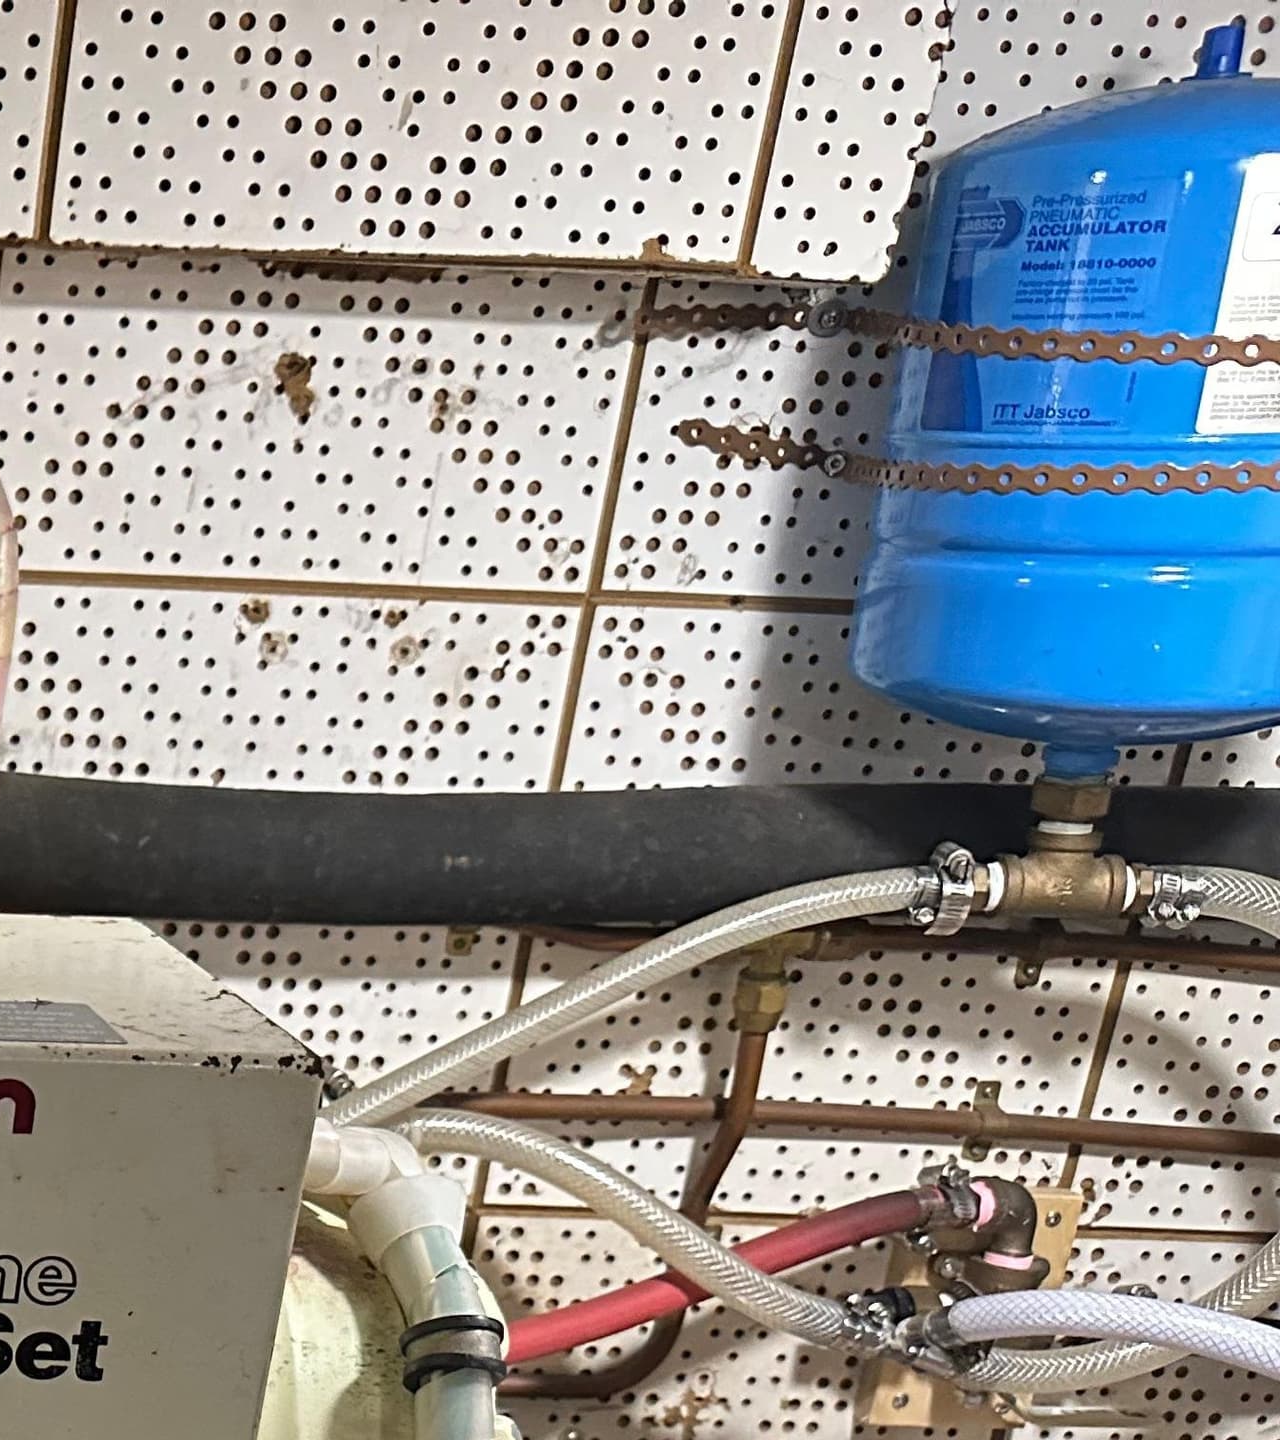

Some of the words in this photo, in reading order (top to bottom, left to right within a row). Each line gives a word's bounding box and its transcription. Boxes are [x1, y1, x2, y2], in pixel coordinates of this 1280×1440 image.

[1029, 206, 1121, 223] PNEUMATIC
[961, 217, 1007, 233] JABSCO
[1027, 219, 1168, 238] ACCUMULATOR
[1025, 238, 1071, 253] TANK
[1021, 259, 1065, 271] Model:
[993, 404, 1021, 419] ITT
[1023, 404, 1091, 420] Jabsco
